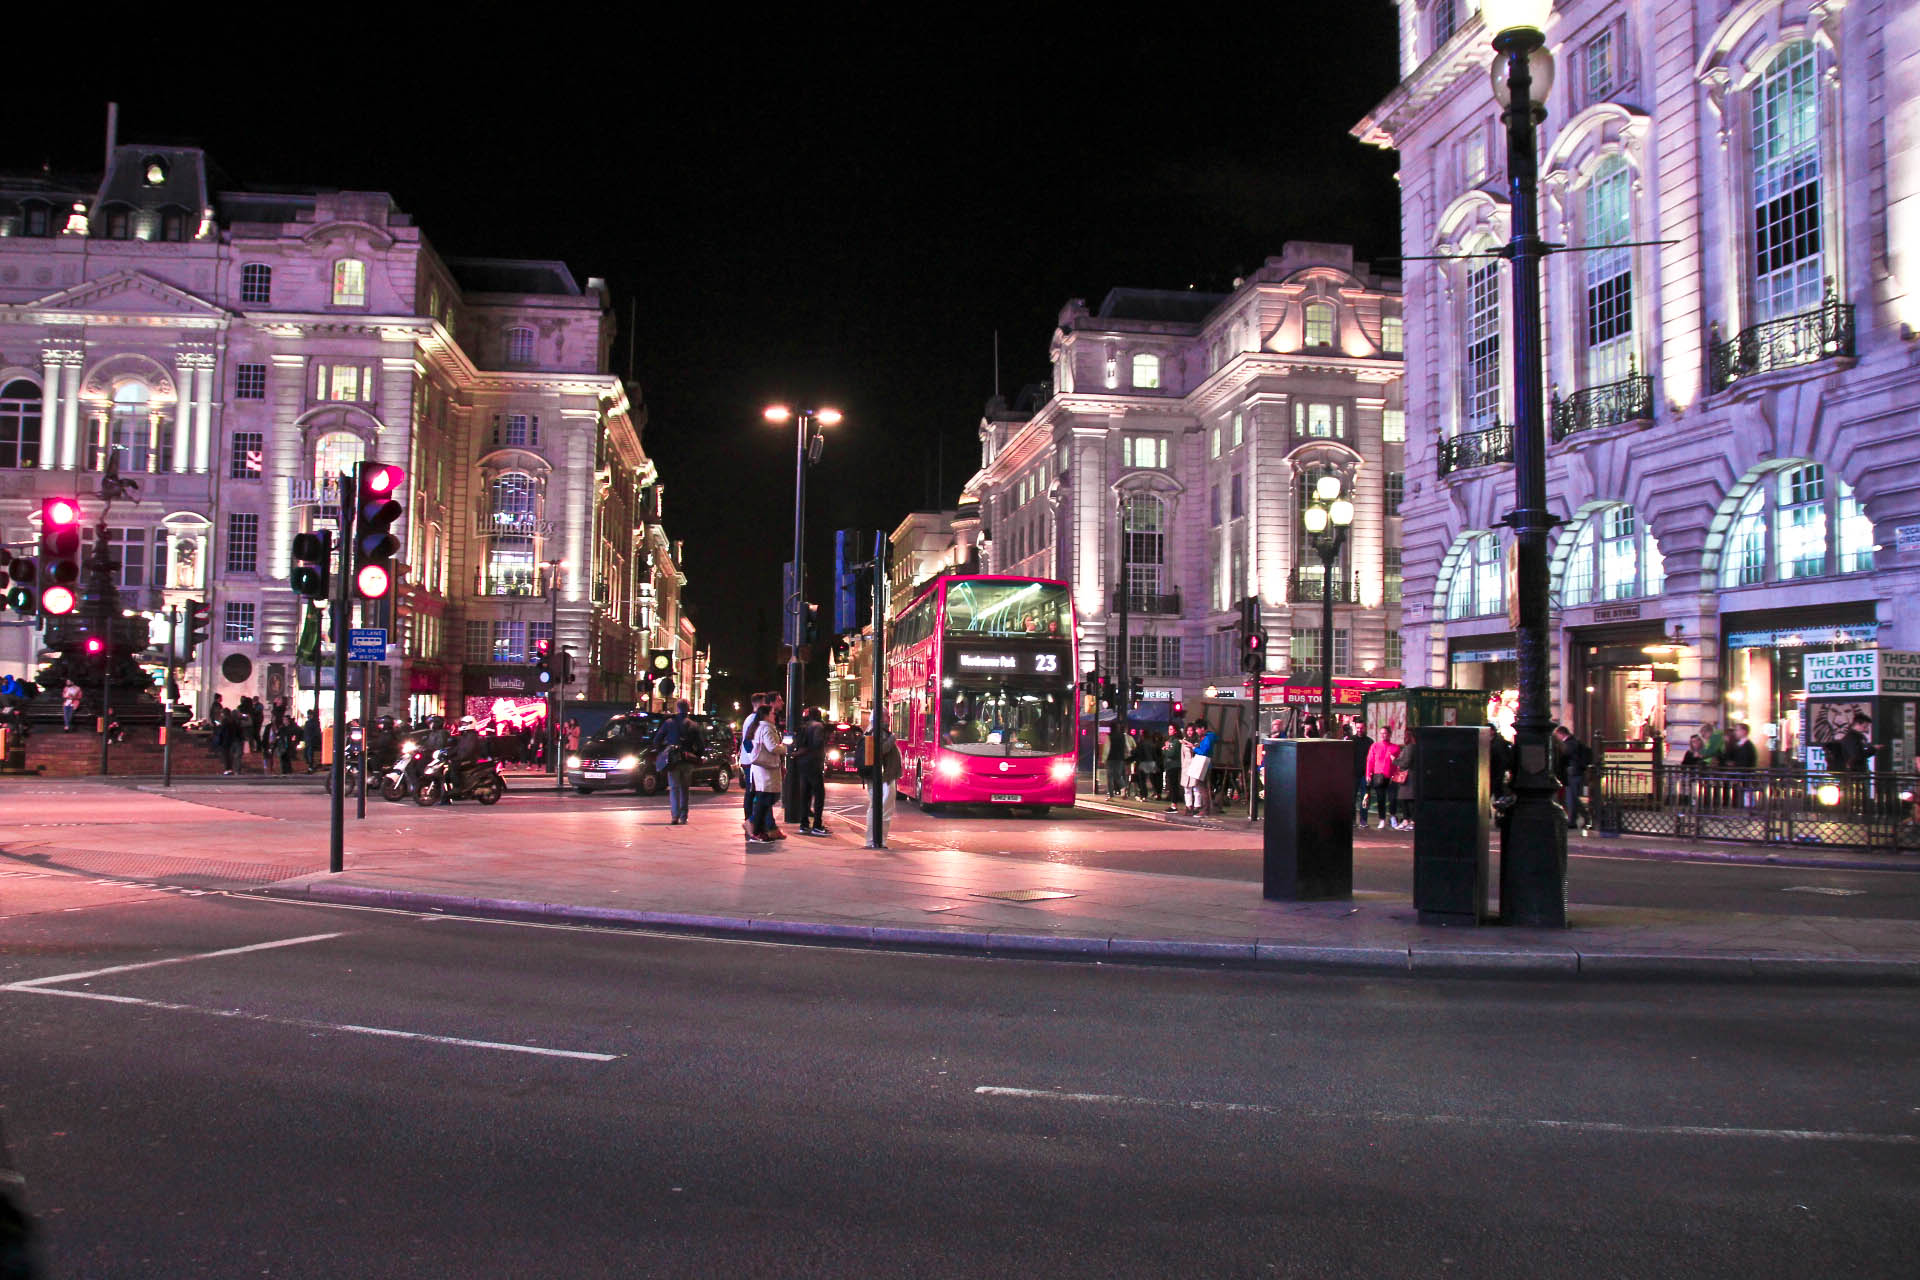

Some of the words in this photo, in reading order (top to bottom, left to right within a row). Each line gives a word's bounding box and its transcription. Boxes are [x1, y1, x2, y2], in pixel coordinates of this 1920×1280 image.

[1035, 654, 1056, 671] 23
[1808, 654, 1874, 667] THEATRE
[1813, 666, 1871, 680] TICKETS
[1810, 683, 1824, 692] ON
[1825, 683, 1847, 691] SALE
[1848, 681, 1873, 690] HERE
[1308, 696, 1337, 704] TOS
